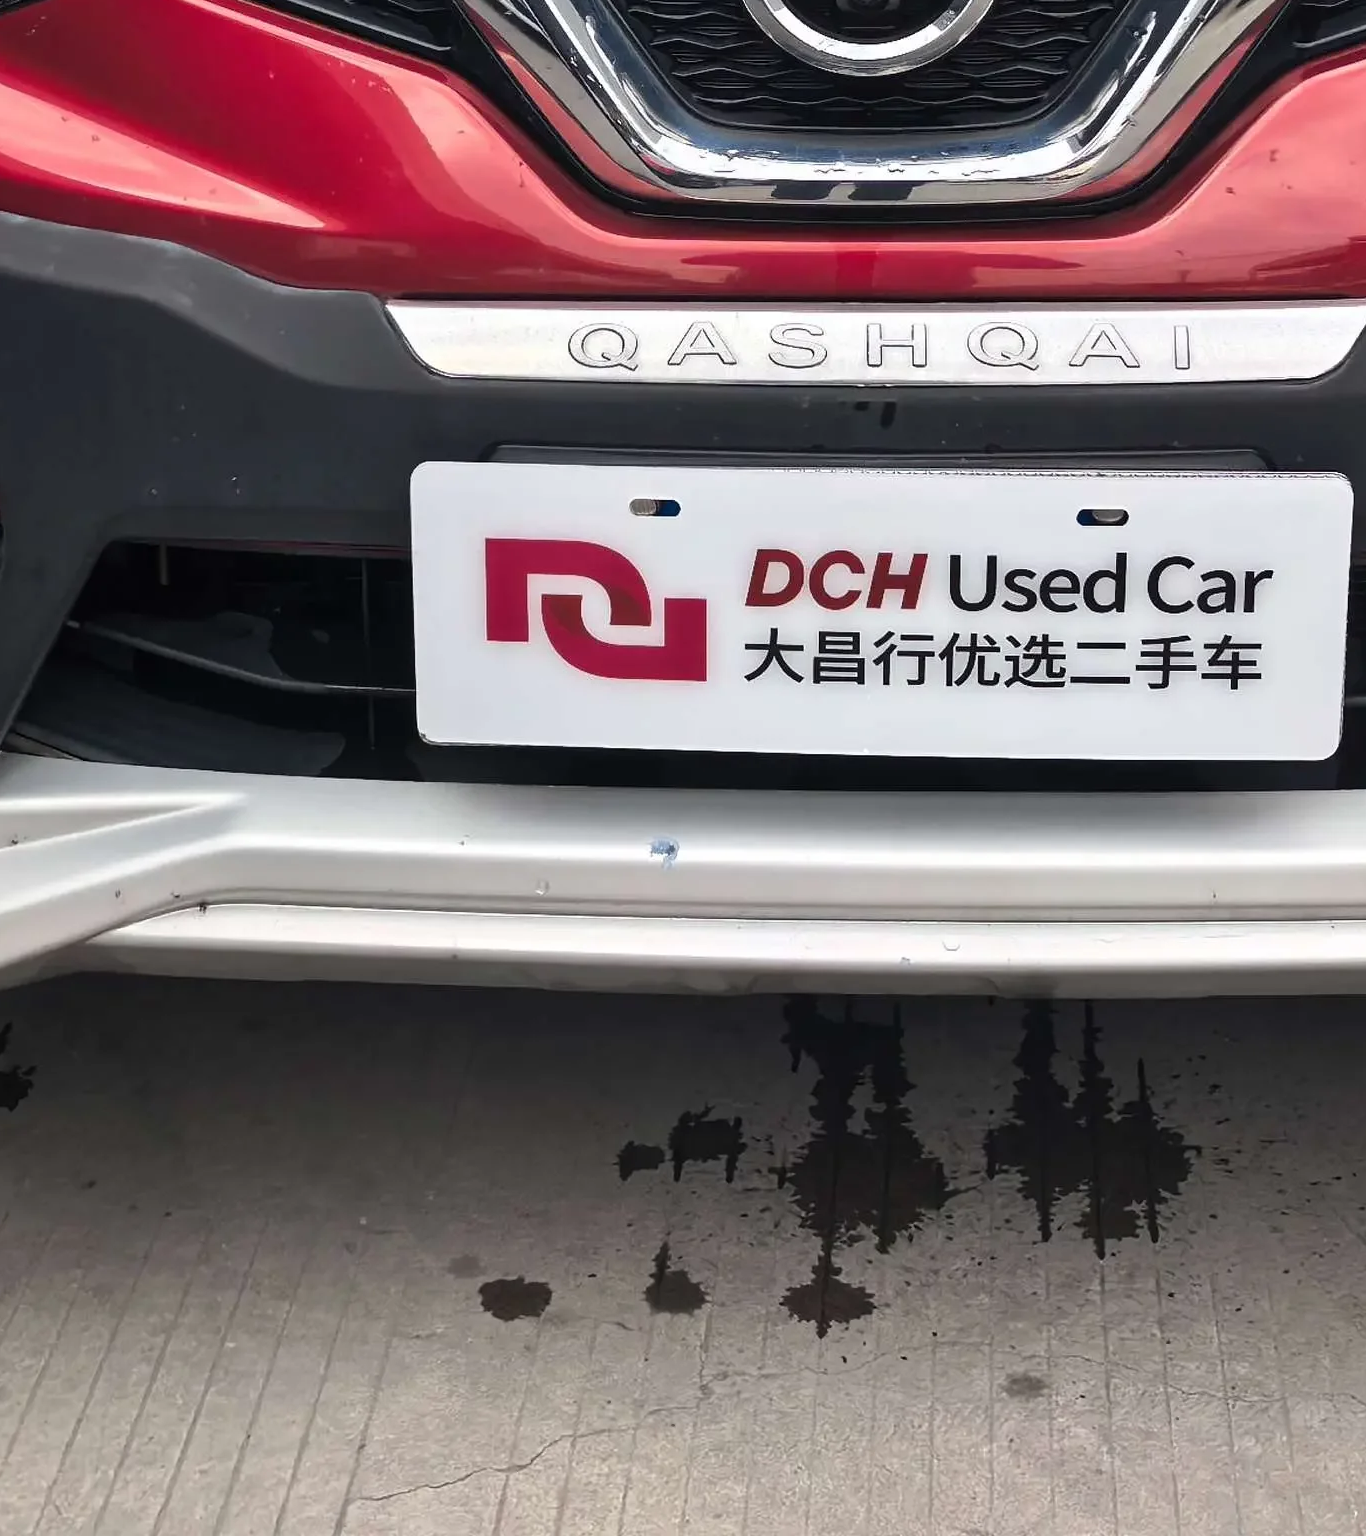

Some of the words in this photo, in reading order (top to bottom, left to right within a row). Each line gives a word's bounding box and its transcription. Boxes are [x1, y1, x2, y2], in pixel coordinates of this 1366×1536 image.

[567, 321, 1193, 373] QASHQAI
[744, 549, 927, 611] DCH
[947, 552, 1127, 615] Used
[1146, 555, 1272, 615] Car
[743, 627, 1265, 691] 大昌行优选二手车
